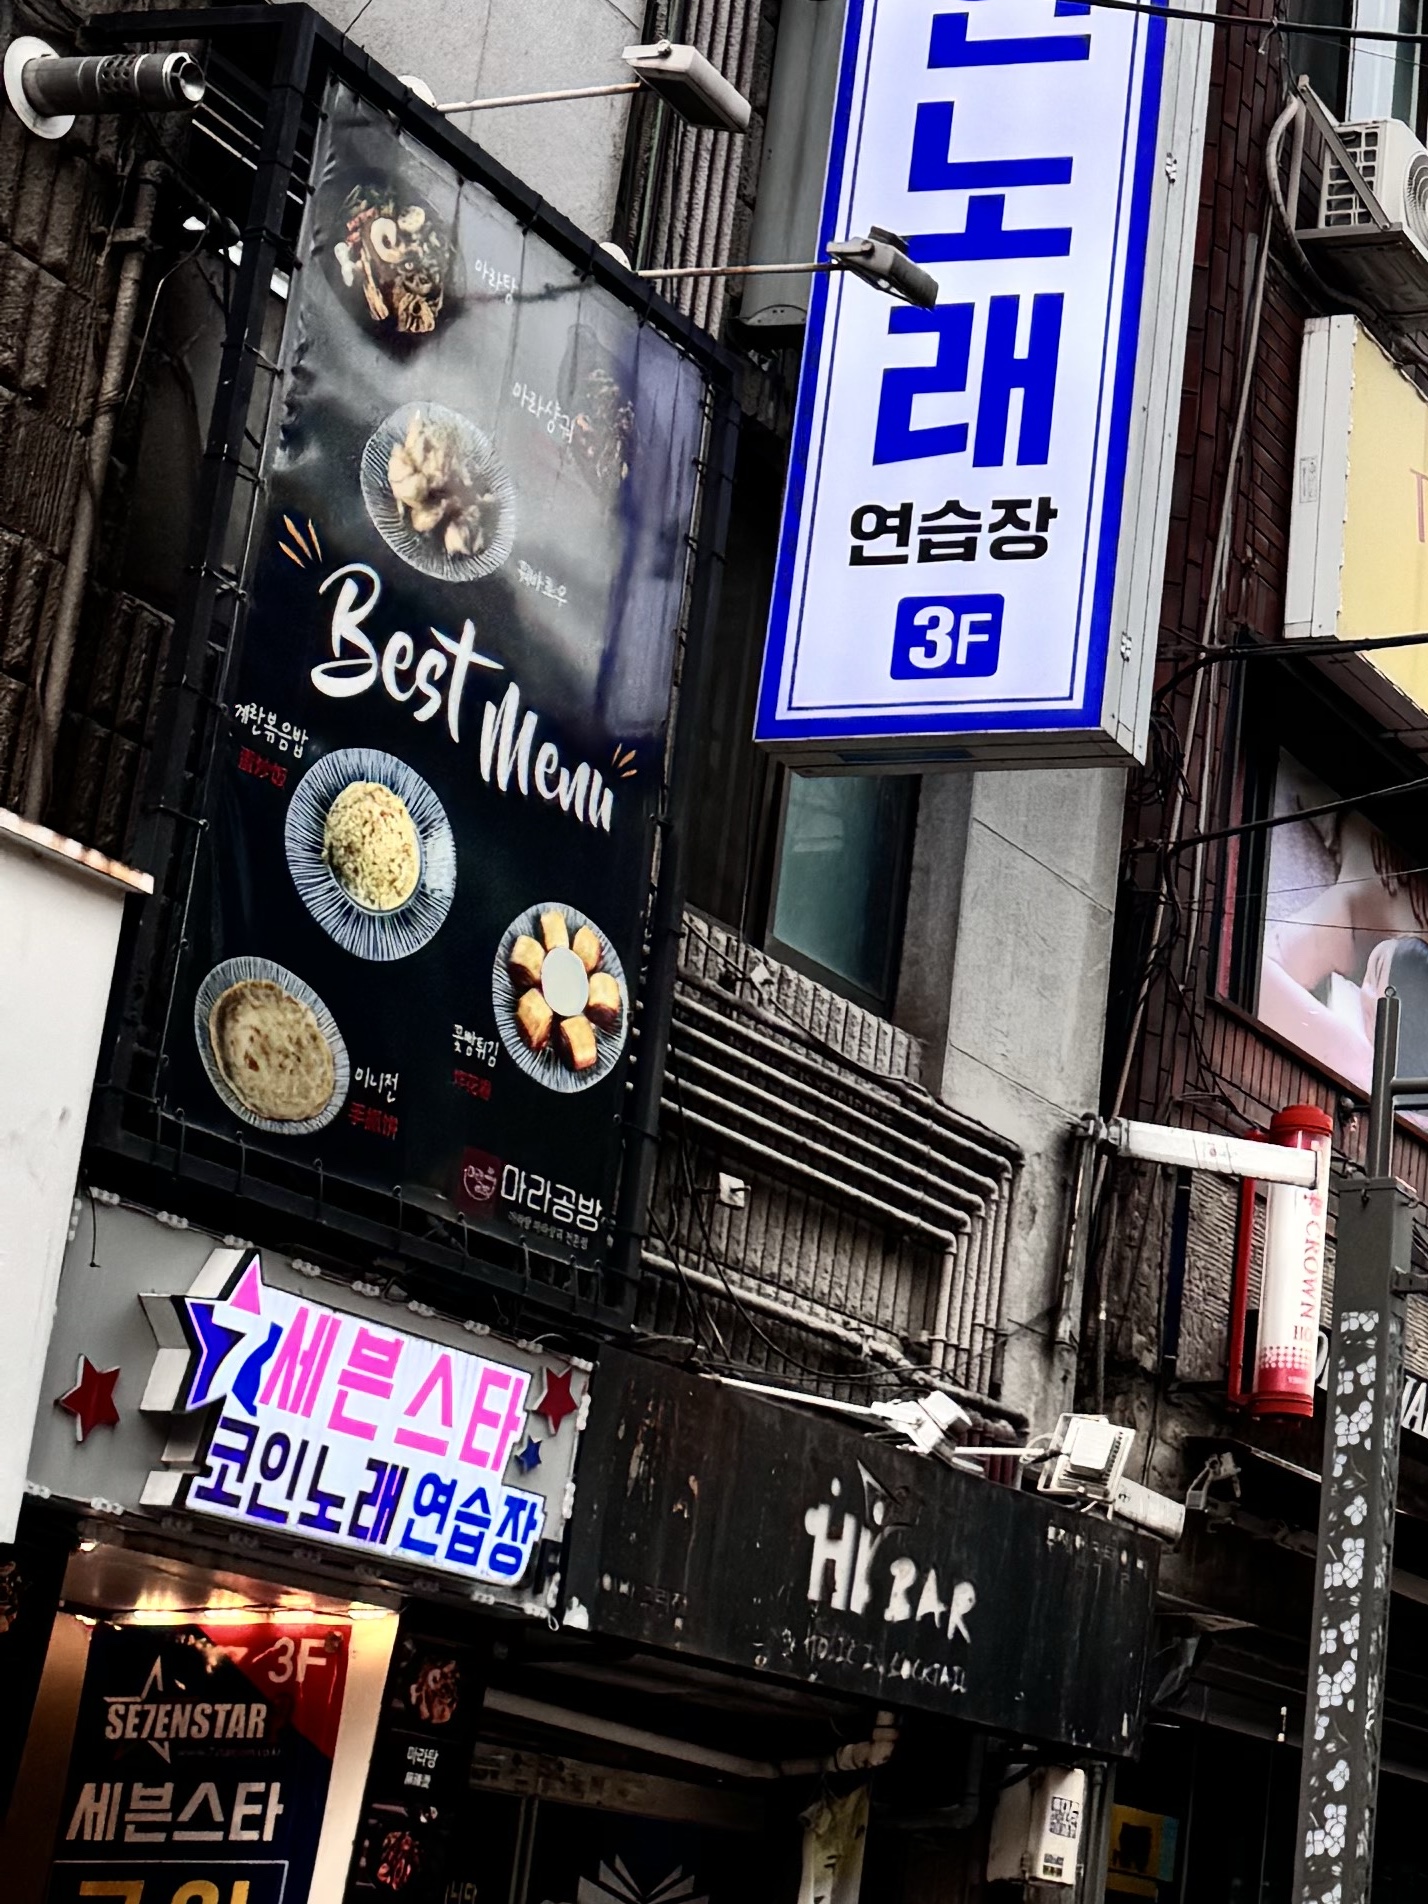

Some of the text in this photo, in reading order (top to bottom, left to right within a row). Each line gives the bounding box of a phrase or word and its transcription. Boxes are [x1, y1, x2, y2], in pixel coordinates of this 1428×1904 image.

[847, 496, 1058, 567] 연습장
[908, 604, 993, 670] 3F
[233, 701, 310, 759] 계란볶음밥
[310, 561, 615, 833] Best Menu
[354, 1066, 399, 1104] 미니전
[500, 1162, 604, 1232] 마라공방
[1299, 1219, 1323, 1321] CROWN
[258, 1305, 531, 1473] 세븐스타
[266, 1636, 327, 1684] 3F
[65, 1781, 285, 1843] 세븐스타
